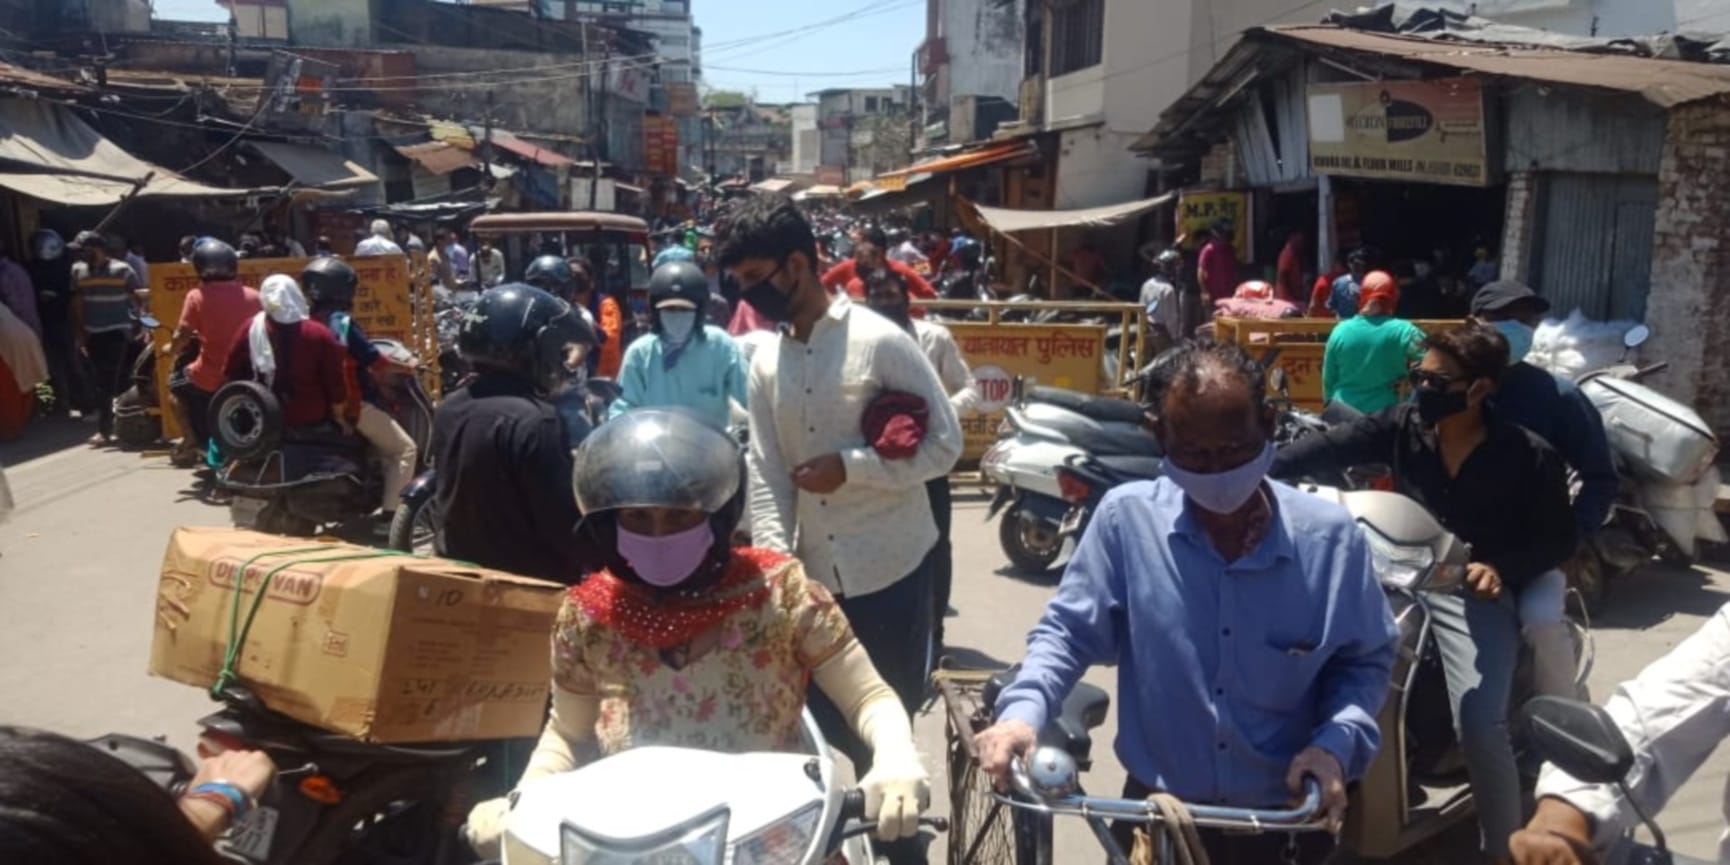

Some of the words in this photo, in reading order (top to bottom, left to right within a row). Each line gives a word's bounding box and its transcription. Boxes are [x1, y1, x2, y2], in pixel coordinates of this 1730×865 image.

[1388, 160, 1413, 172] MILLS
[1035, 331, 1097, 364] पुलिस
[273, 574, 313, 597] VAN
